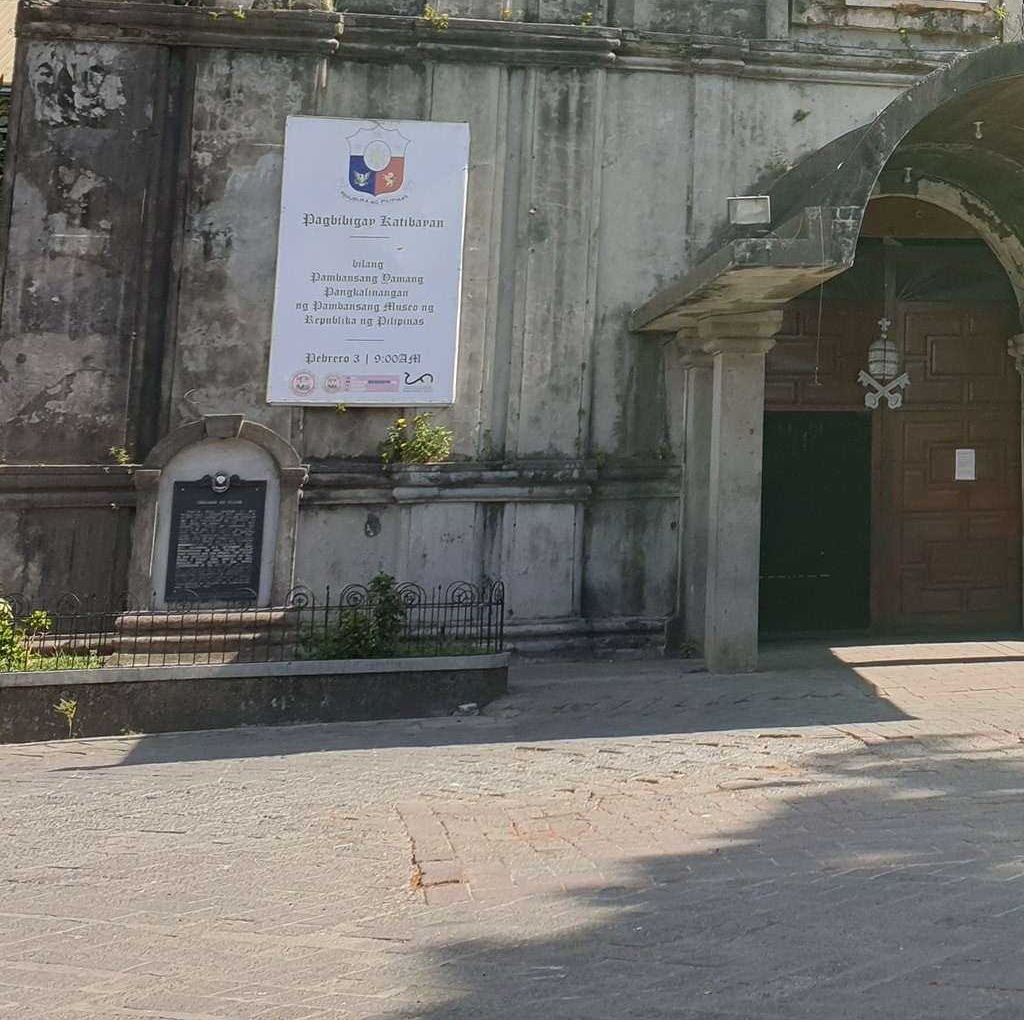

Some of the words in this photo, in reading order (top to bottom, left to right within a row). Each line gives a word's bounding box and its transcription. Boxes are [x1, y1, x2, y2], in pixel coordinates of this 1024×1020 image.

[303, 214, 375, 228] Pagbibigay
[380, 215, 444, 228] Katibayan
[353, 260, 384, 269] bilang
[310, 272, 378, 284] Pambansang
[382, 274, 424, 285] Yamang
[324, 287, 409, 298] Pangkalinangan
[296, 303, 308, 311] ng
[312, 301, 380, 312] Pambansang
[382, 302, 418, 312] Museo
[421, 305, 434, 313] ng
[304, 315, 357, 325] Republika
[360, 318, 373, 326] ng
[377, 316, 424, 327] Pilipinas
[305, 353, 349, 364] Pebrero
[353, 354, 360, 363] 3
[374, 354, 421, 364] 9:00AM
